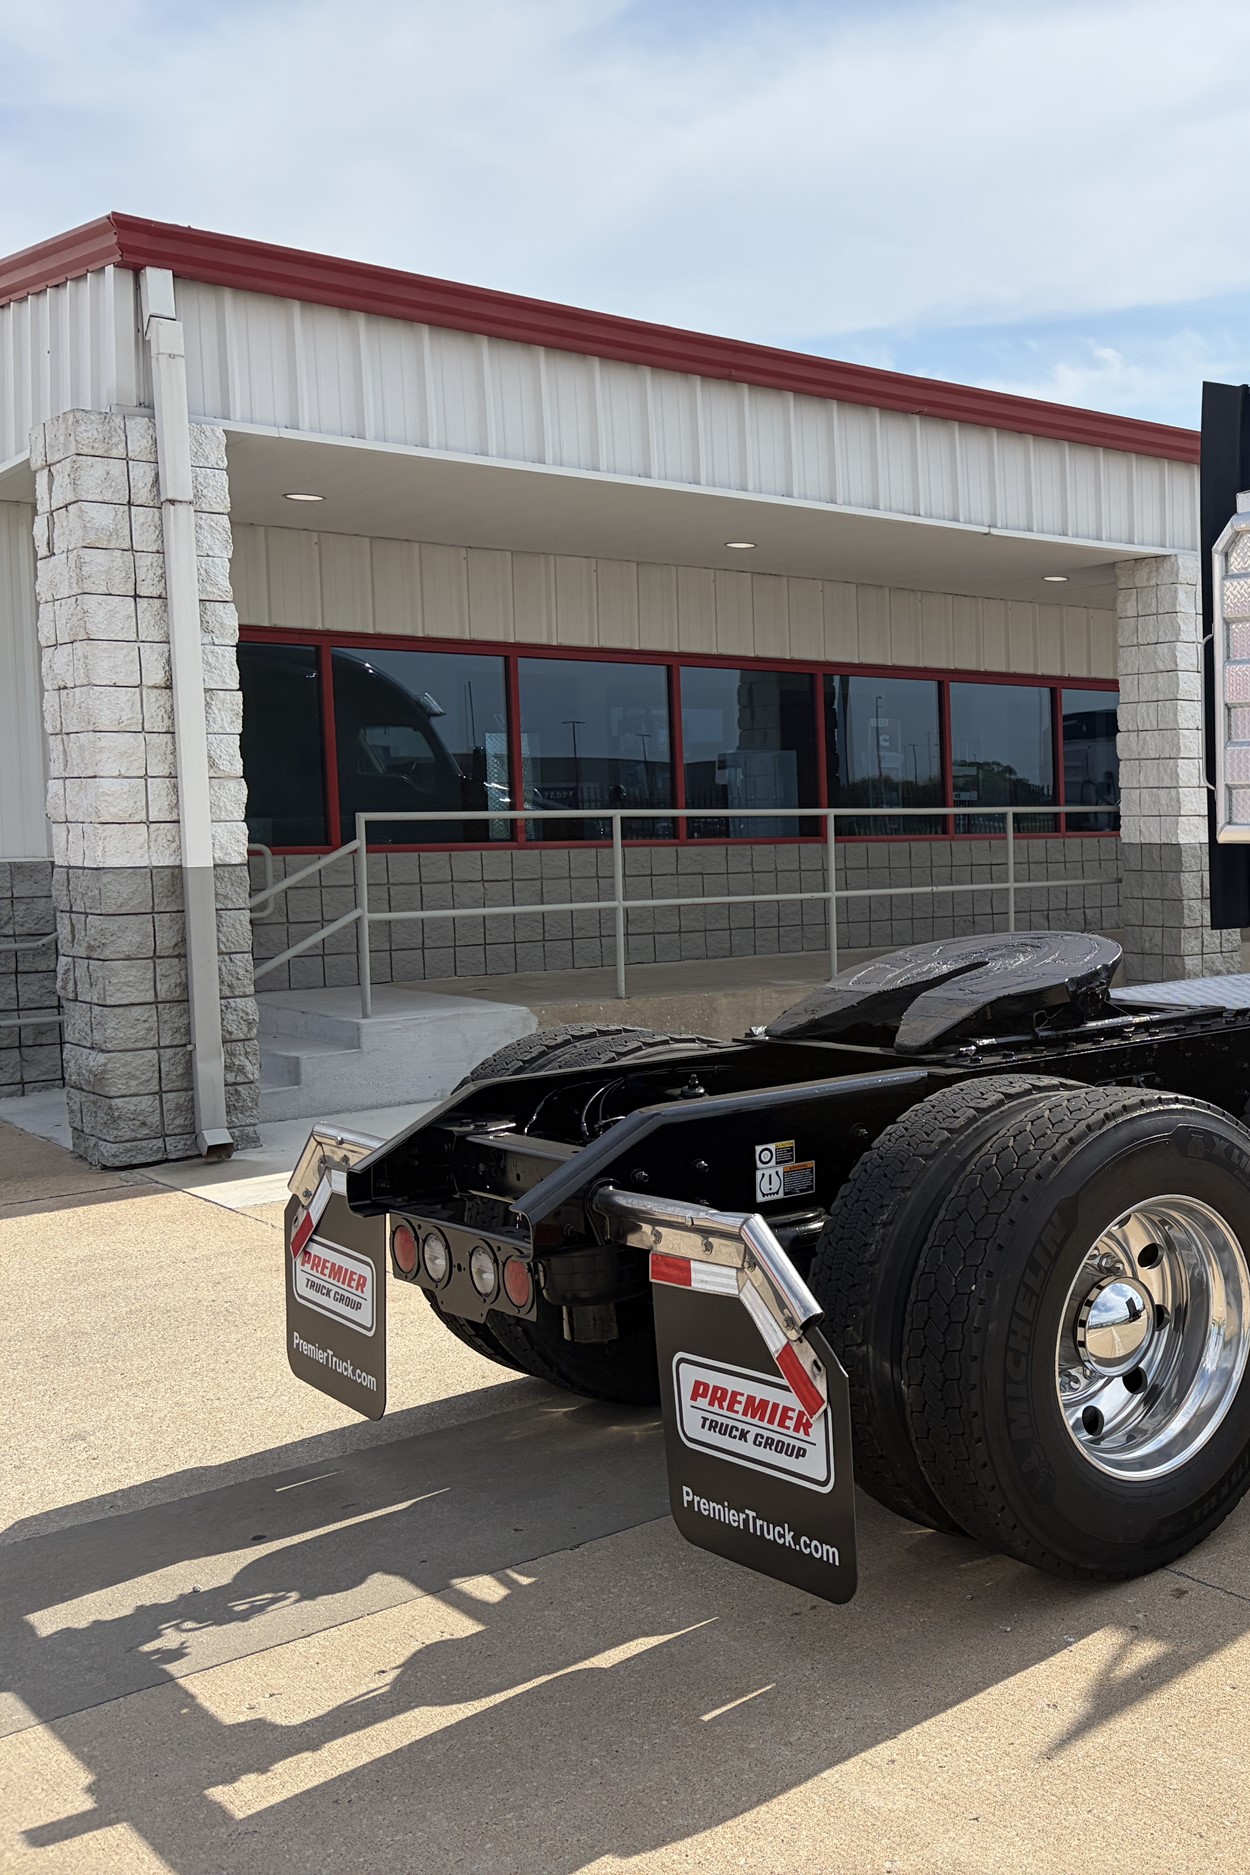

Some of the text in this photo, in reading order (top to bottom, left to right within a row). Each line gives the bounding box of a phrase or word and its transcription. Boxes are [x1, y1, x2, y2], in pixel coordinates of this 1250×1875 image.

[301, 1251, 367, 1294] PREMIER
[305, 1278, 362, 1312] TRUCK GROUP
[1005, 1209, 1069, 1440] MICHELIN
[293, 1331, 377, 1391] PremierTruck.com
[690, 1379, 813, 1437] PREMIER
[700, 1416, 807, 1460] TRUCK GROUP
[682, 1485, 839, 1566] PremierTruck.com
